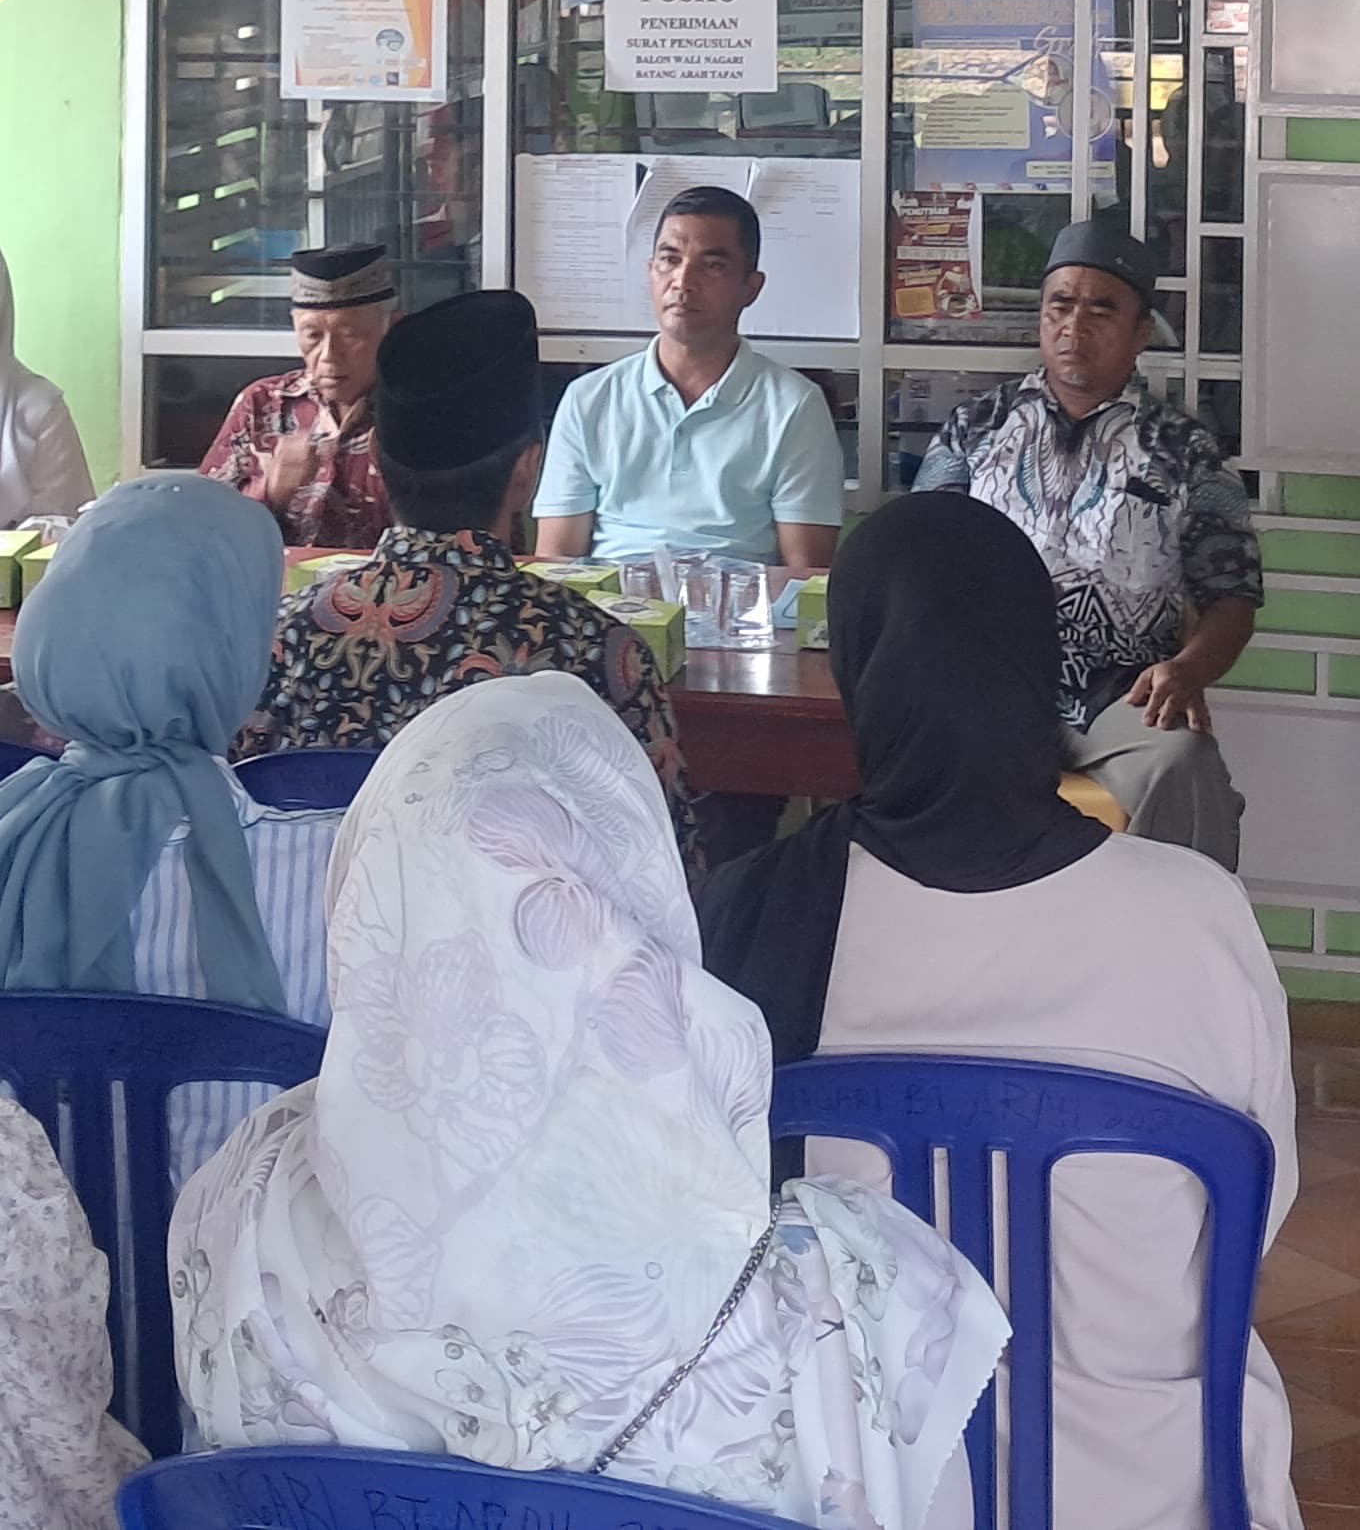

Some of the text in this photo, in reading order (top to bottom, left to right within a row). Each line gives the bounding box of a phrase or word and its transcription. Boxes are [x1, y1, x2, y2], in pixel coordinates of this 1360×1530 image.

[640, 17, 739, 30] PENERIMAAN
[626, 37, 752, 49] SURAT PENGUSULAN
[635, 55, 744, 65] BALON WALI NAGARI
